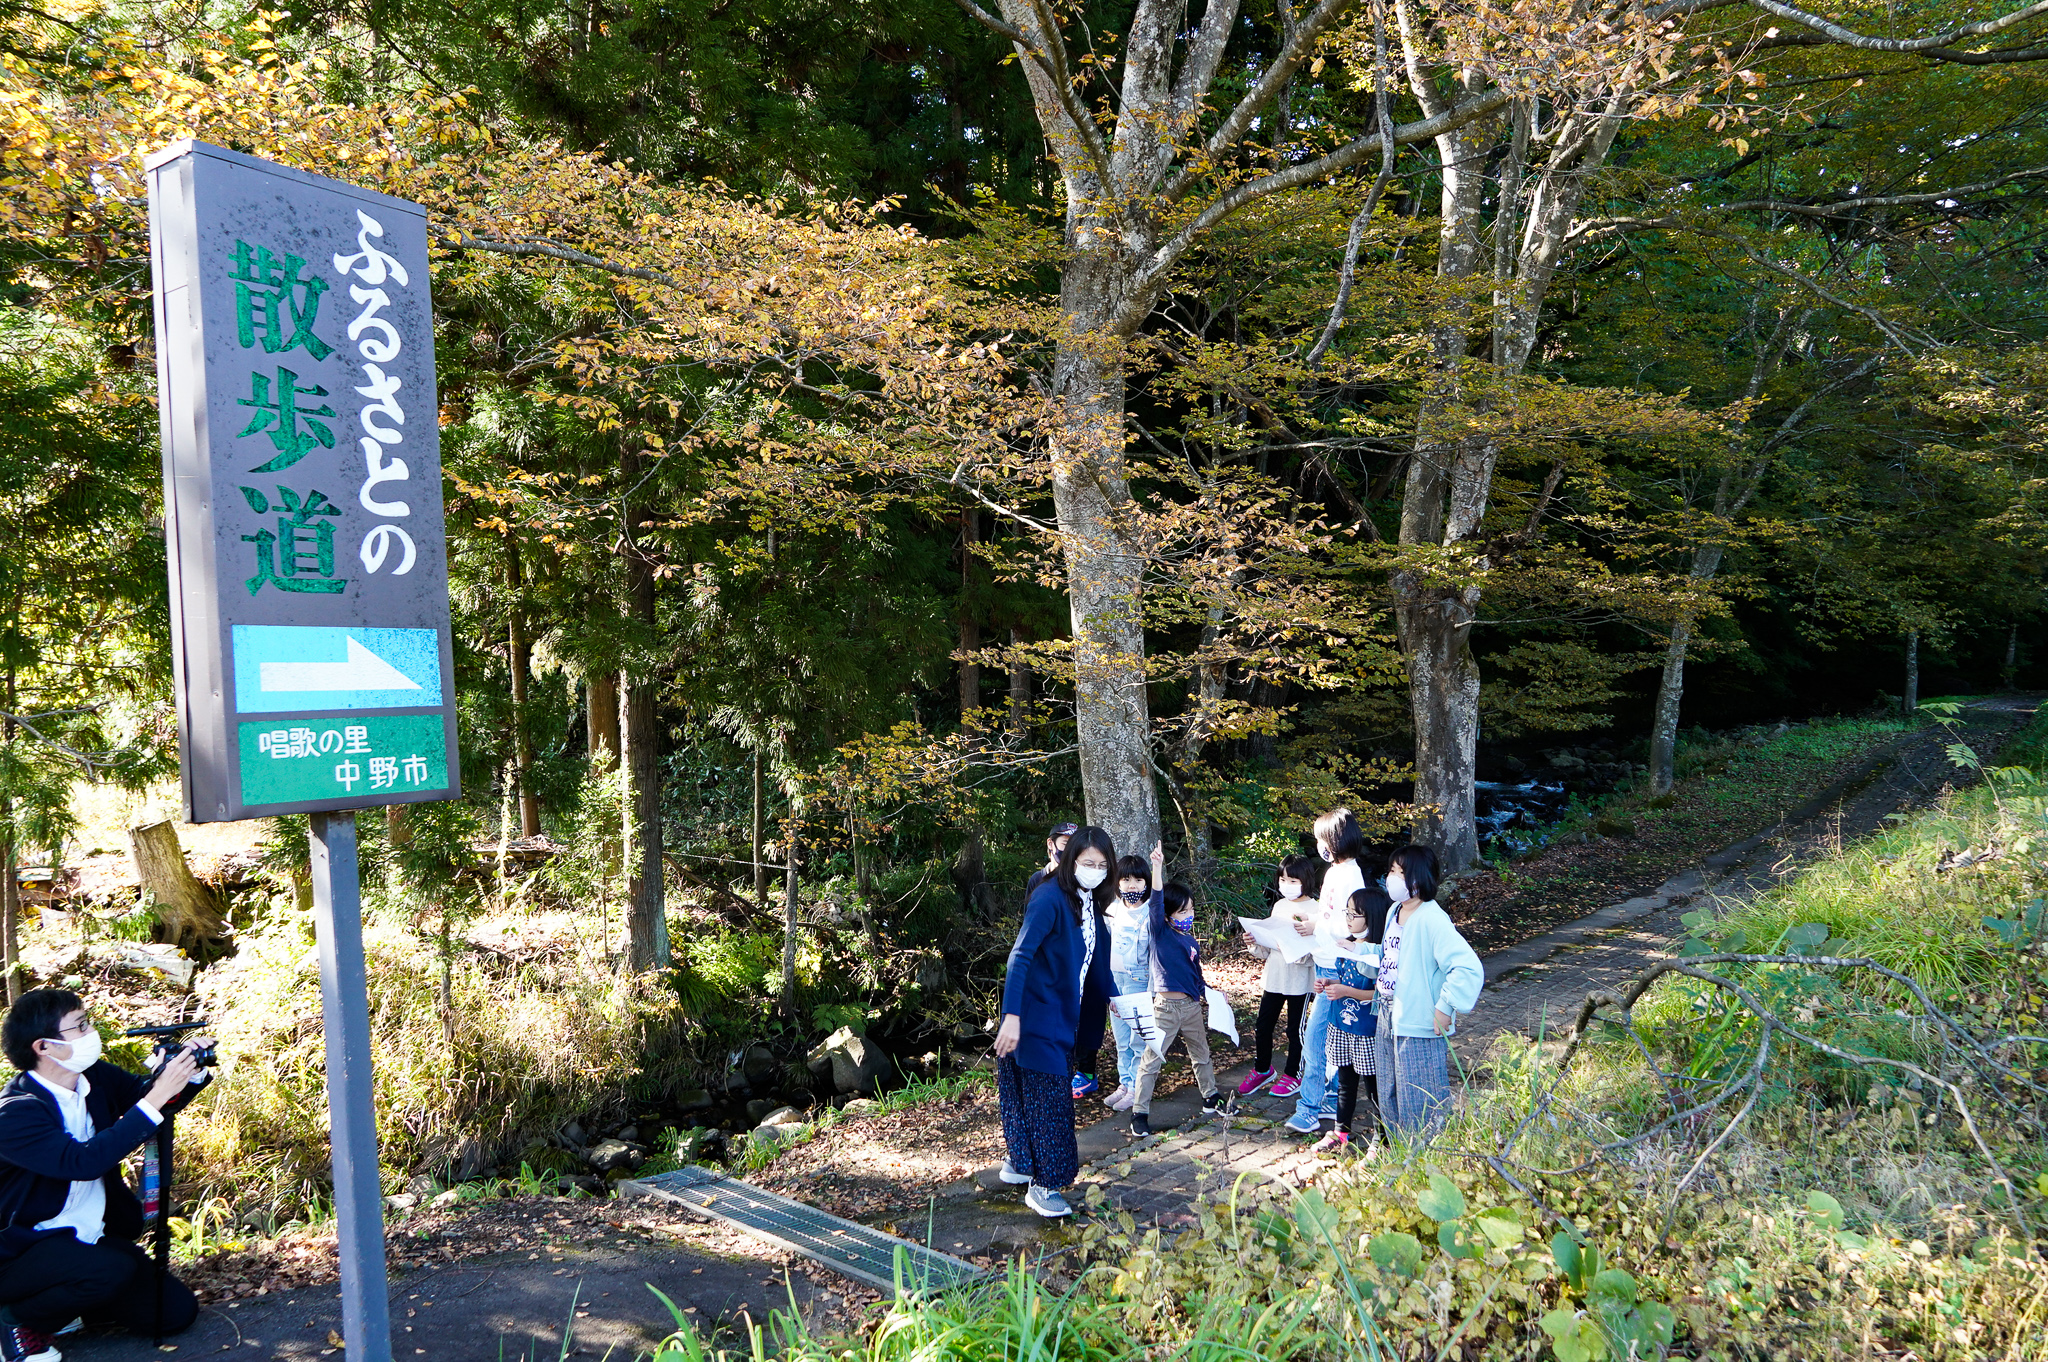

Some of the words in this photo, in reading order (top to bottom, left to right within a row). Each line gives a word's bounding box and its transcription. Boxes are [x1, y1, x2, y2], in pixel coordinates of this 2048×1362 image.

[228, 239, 349, 597] 散歩道
[333, 208, 417, 575] ふるさとの
[258, 725, 373, 759] 唱歌の里
[334, 753, 428, 792] 中野市
